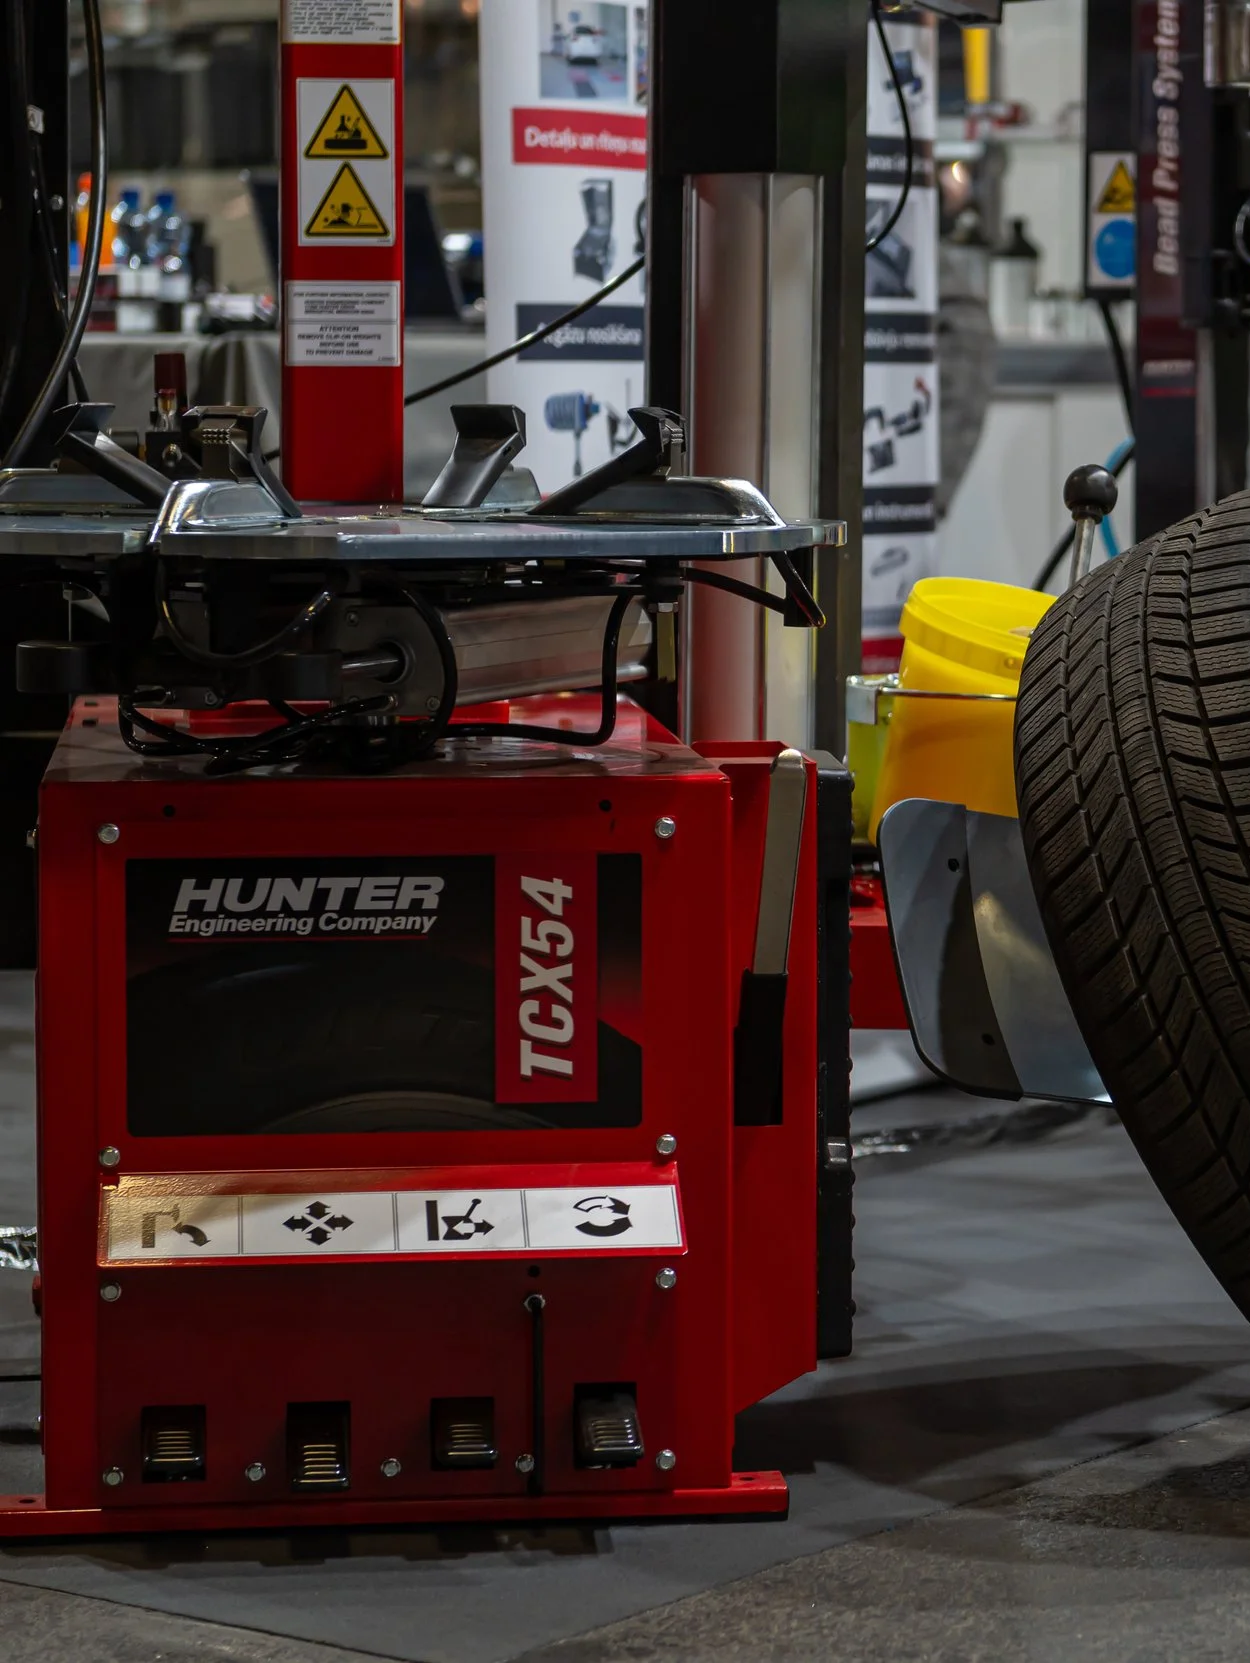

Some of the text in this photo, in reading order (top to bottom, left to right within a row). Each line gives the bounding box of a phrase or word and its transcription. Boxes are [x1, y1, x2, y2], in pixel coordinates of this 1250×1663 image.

[1152, 105, 1180, 191] Press
[1152, 197, 1180, 276] Bead
[168, 912, 438, 937] Engineering Company
[172, 876, 446, 913] HUNTER
[518, 875, 575, 1078] TCX54
